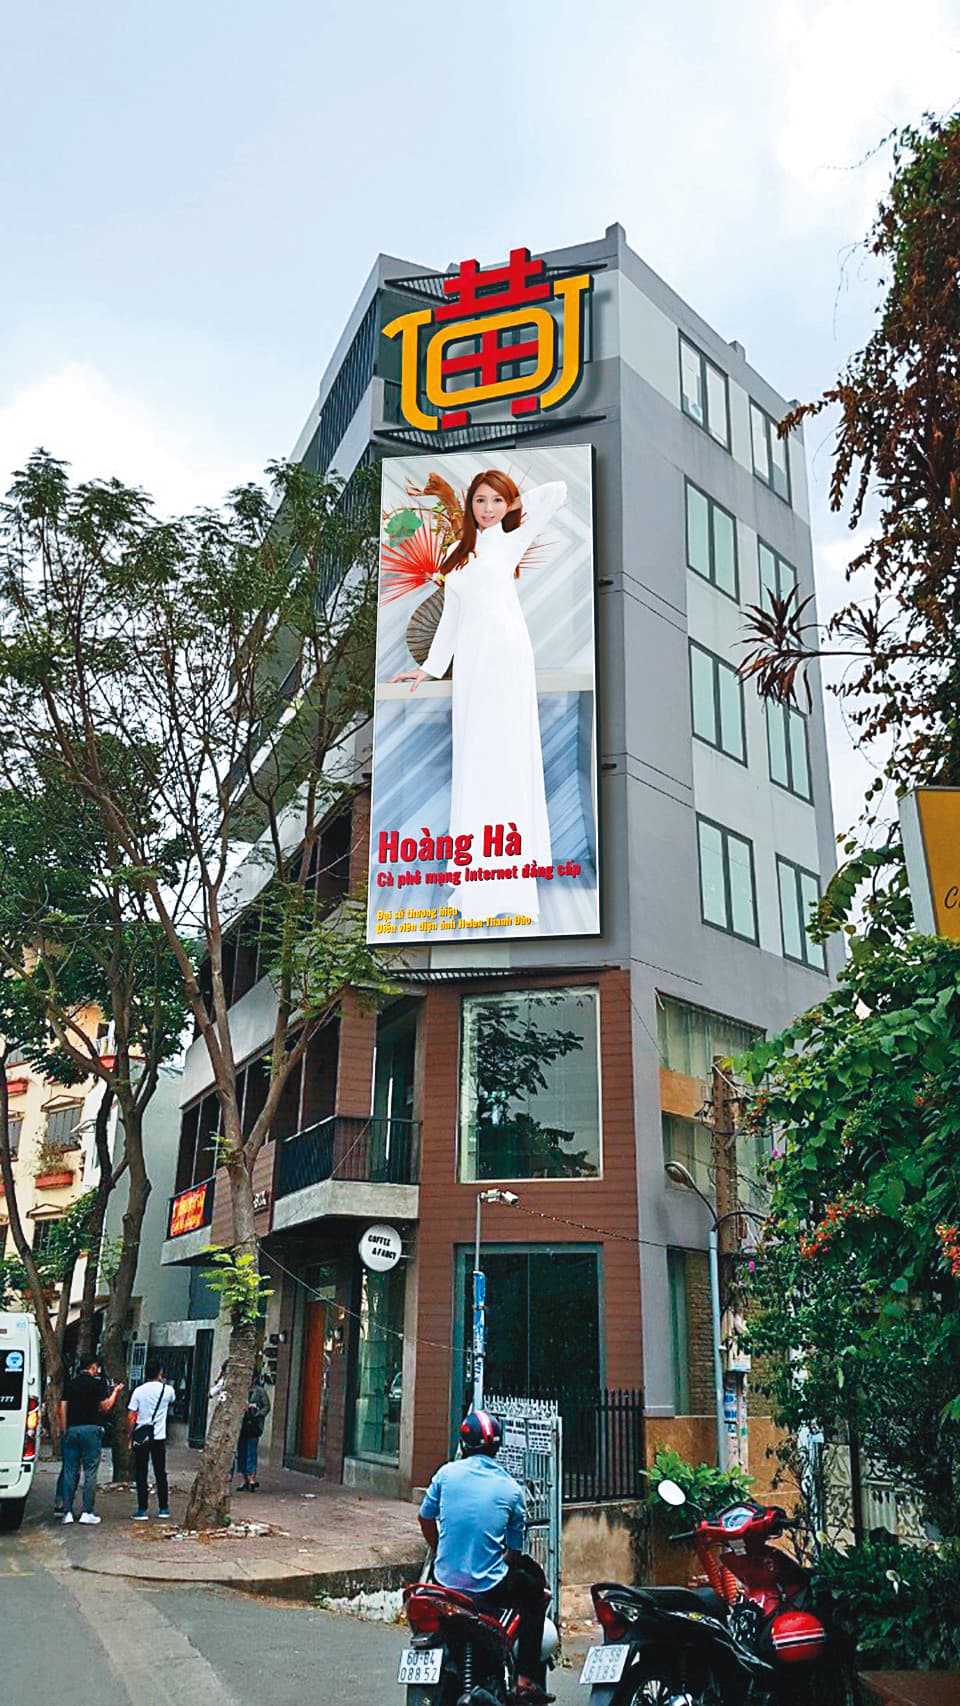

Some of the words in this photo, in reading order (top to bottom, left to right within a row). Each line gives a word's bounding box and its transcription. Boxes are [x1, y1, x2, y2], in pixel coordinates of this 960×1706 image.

[378, 827, 474, 866] Hoàng
[482, 822, 522, 857] Hà
[397, 869, 421, 889] phê
[424, 871, 461, 887] mạng
[465, 865, 518, 882] Internet
[556, 859, 581, 879] cấp
